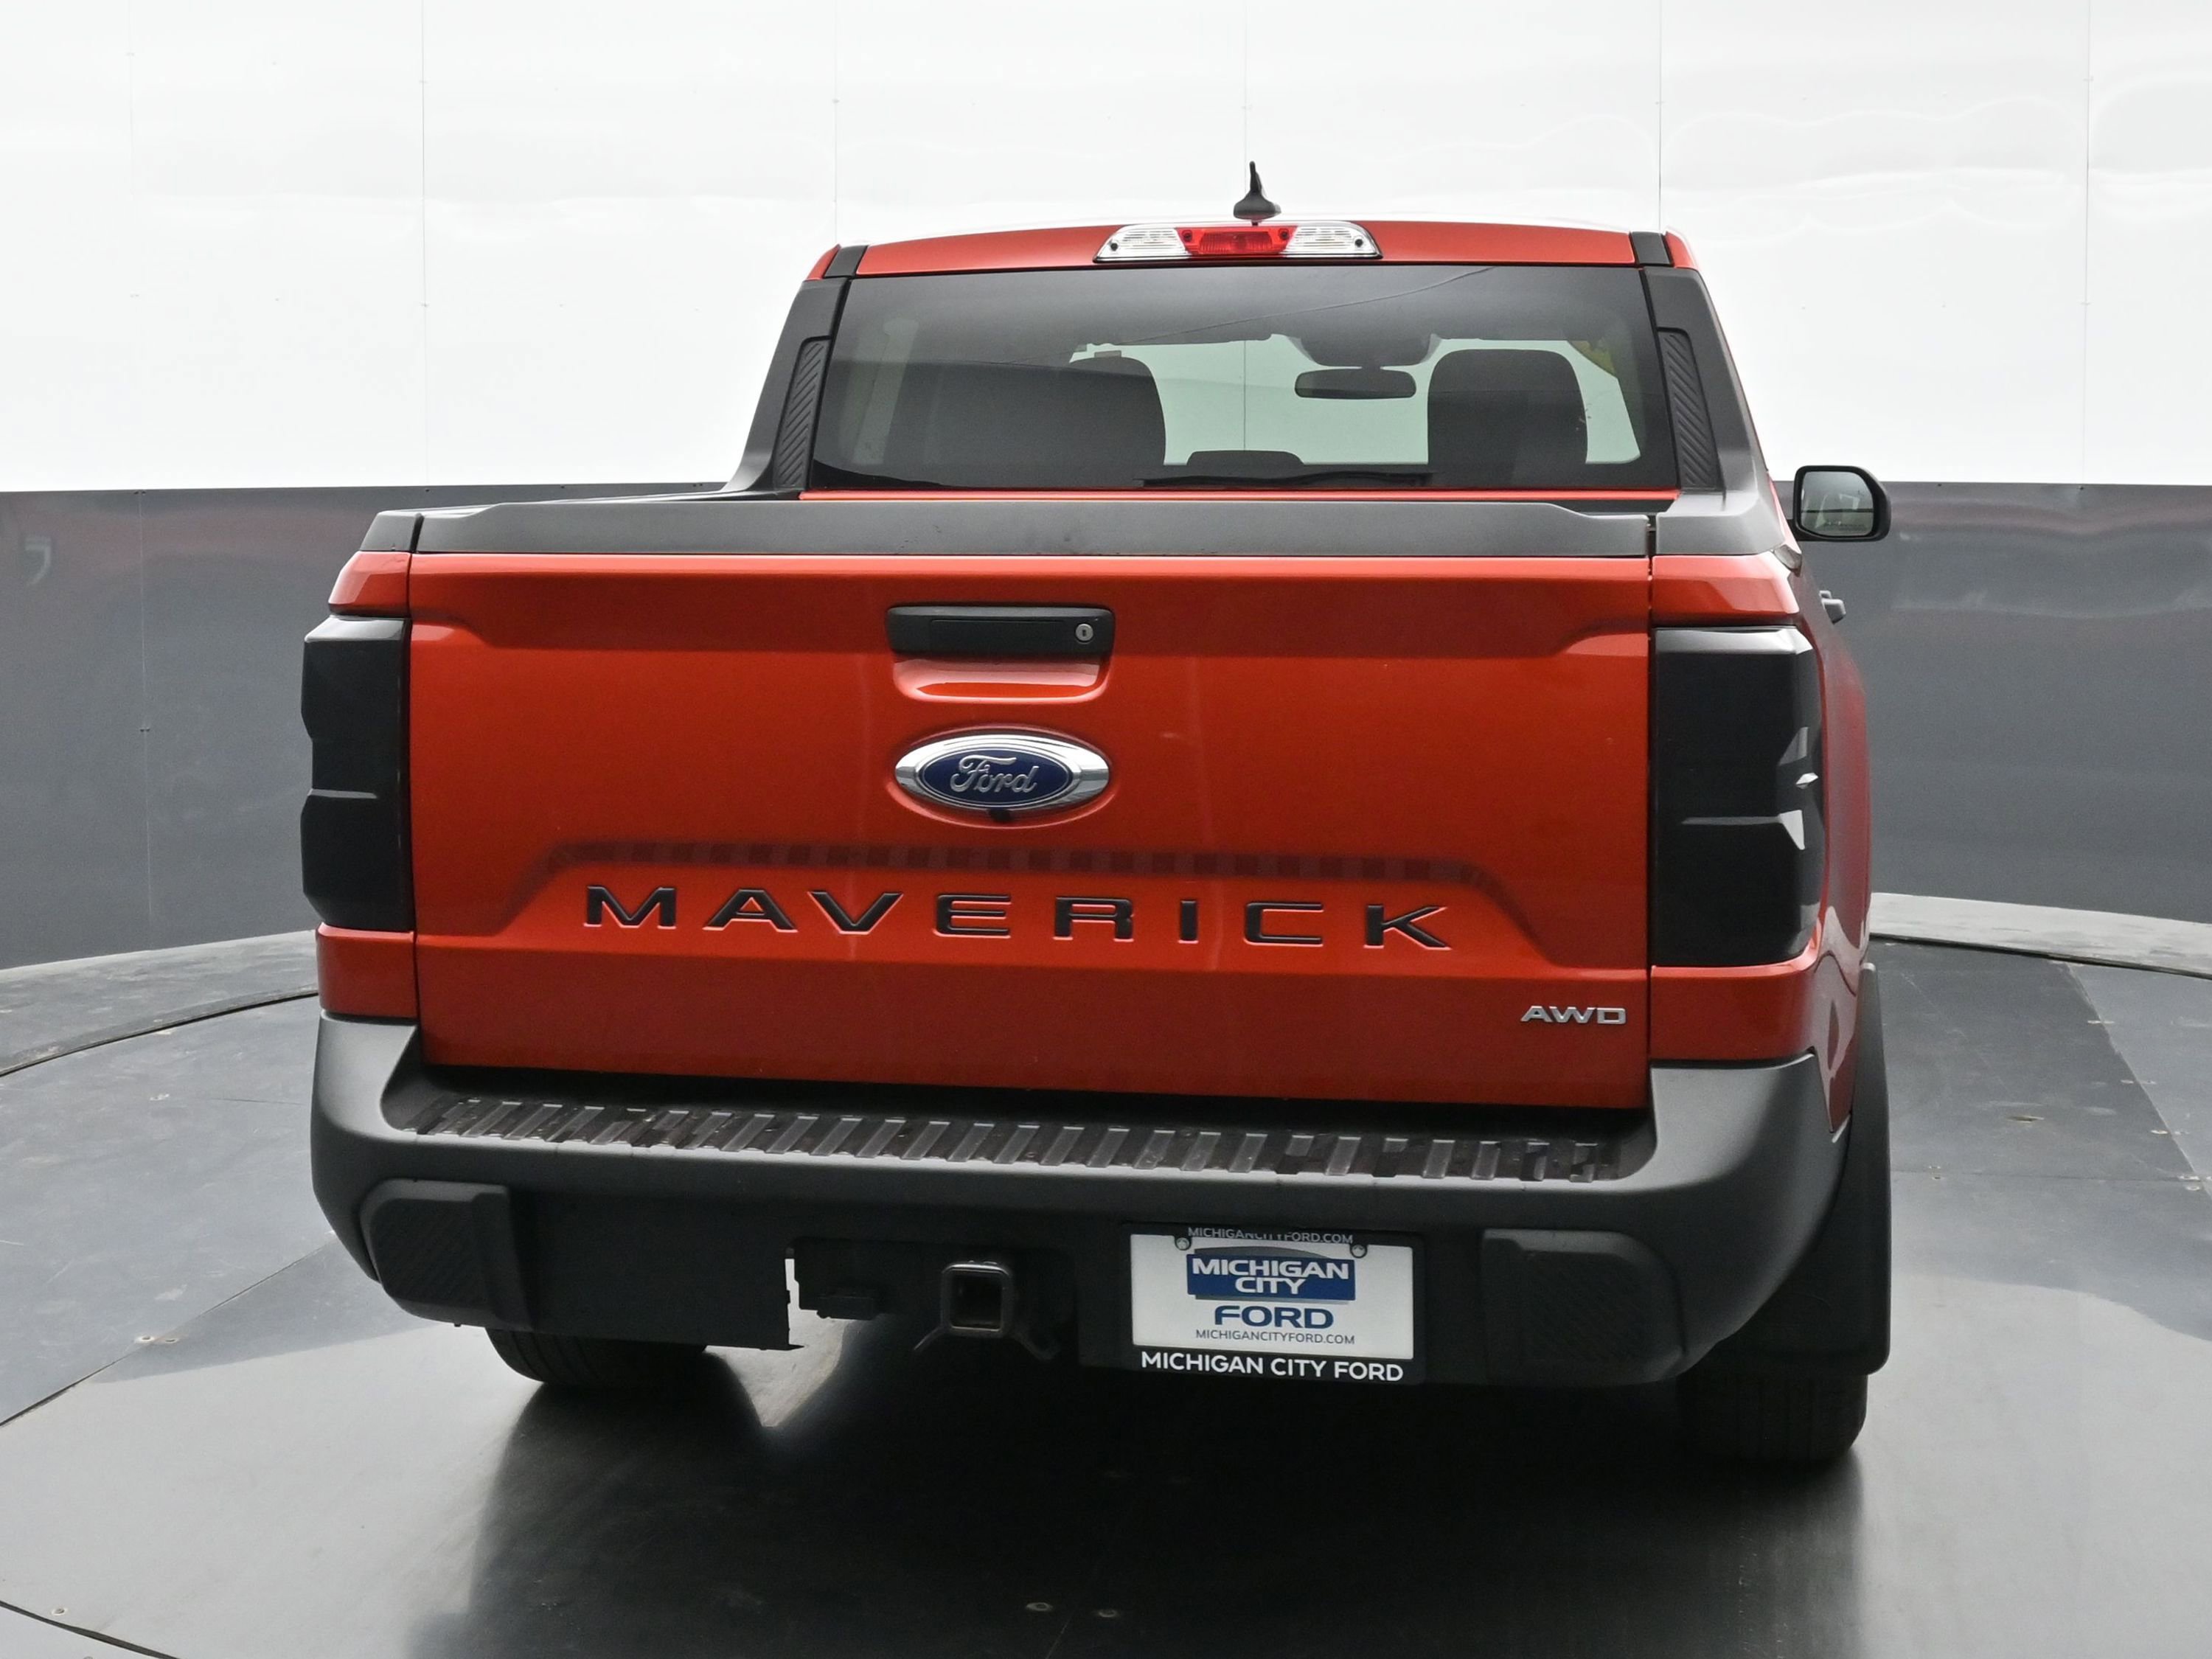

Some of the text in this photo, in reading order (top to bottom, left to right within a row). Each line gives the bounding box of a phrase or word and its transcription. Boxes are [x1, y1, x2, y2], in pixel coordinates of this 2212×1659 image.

[950, 754, 1040, 793] Ford
[585, 886, 1451, 951] MAVERICK
[1520, 1005, 1627, 1025] AWD
[1192, 1257, 1349, 1280] MICHIGAN
[1235, 1276, 1306, 1295] CITY
[1214, 1305, 1334, 1329] FORD
[1196, 1329, 1355, 1345] MICHIGANCITYFORD.COM
[1141, 1351, 1403, 1382] MICHIGAN CITY FORD
